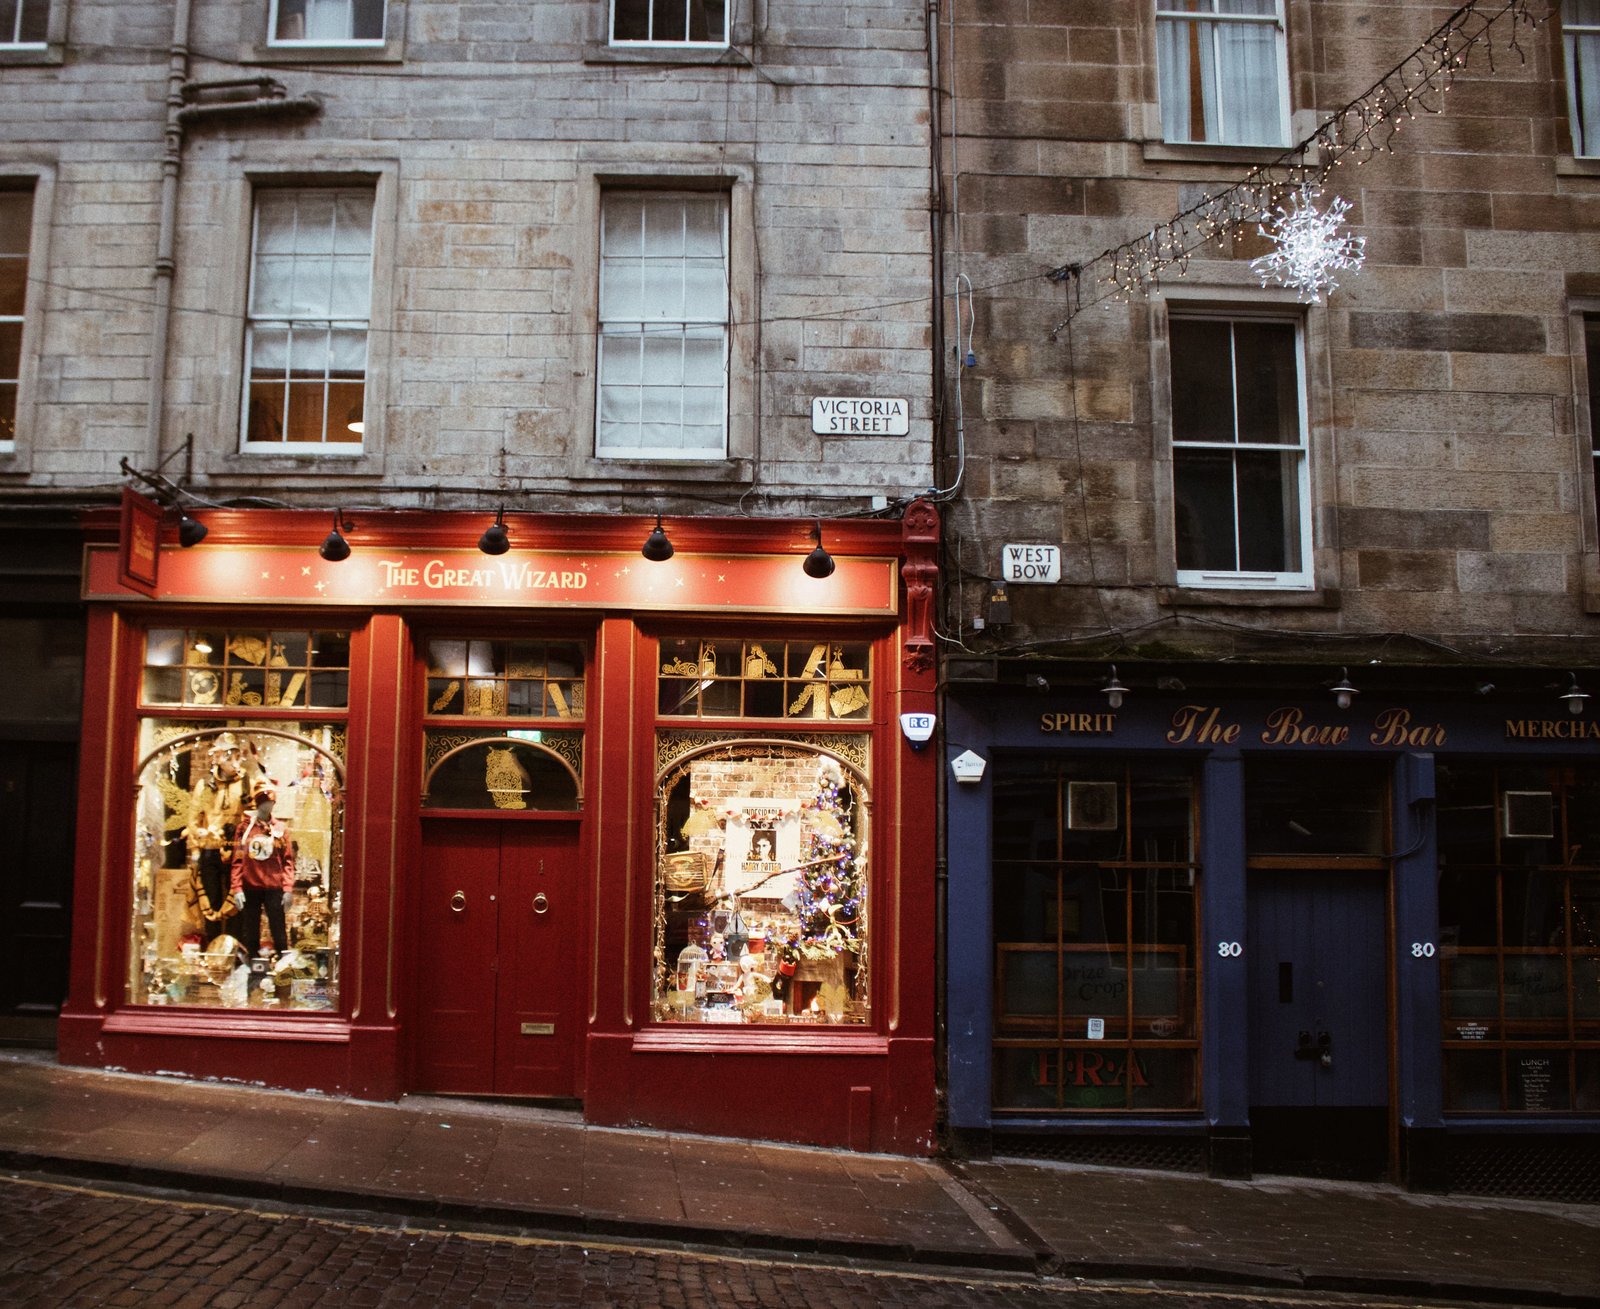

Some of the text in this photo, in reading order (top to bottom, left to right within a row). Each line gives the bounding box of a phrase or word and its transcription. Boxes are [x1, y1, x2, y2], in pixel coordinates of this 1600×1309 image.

[819, 400, 902, 416] VICTORIA
[830, 416, 892, 432] STREET
[1009, 547, 1055, 563] WEST
[1012, 564, 1051, 579] BOW
[910, 717, 929, 728] RG
[1041, 713, 1117, 733] SPIRIT
[1166, 705, 1448, 747] The Bow Bar
[1505, 719, 1600, 739] MERCHA
[1218, 942, 1242, 957] 80
[1411, 942, 1435, 958] 80
